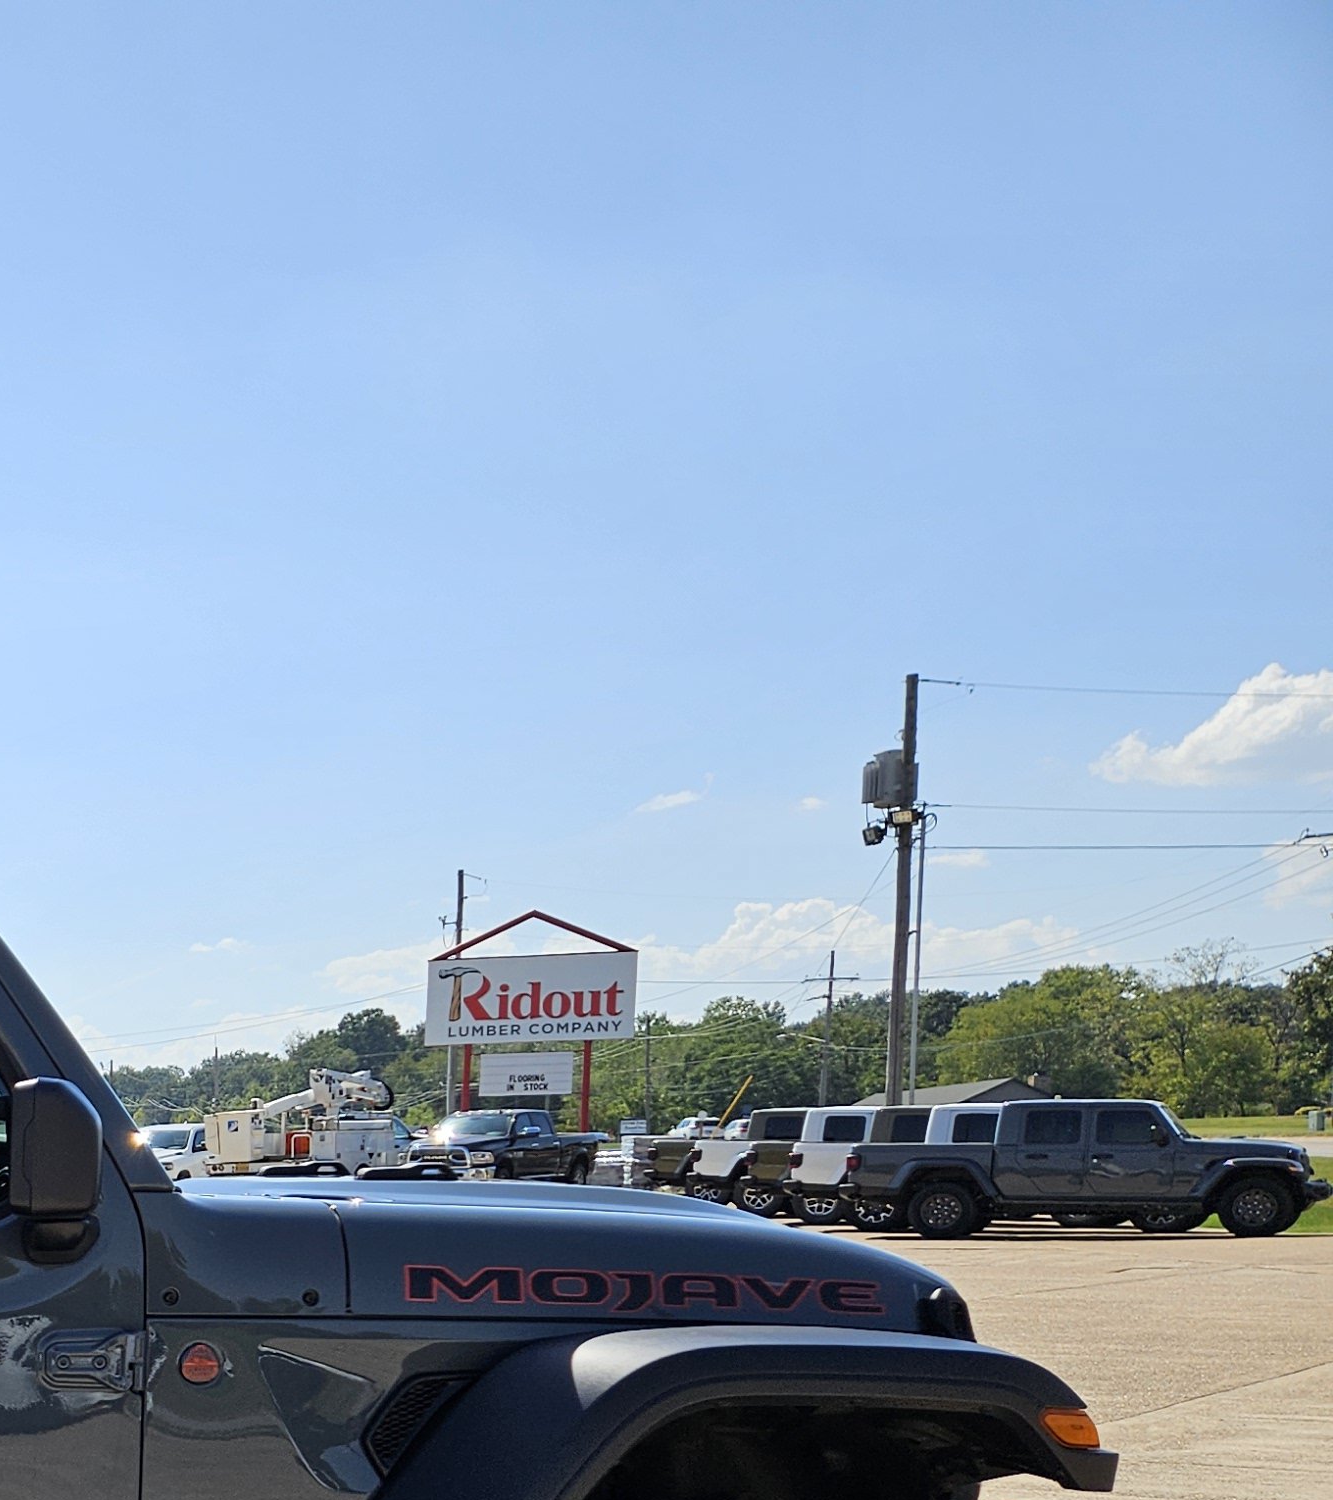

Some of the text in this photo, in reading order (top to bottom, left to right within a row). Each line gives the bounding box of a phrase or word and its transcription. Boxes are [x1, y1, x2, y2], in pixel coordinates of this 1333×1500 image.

[439, 967, 624, 1022] Ridout
[448, 1020, 623, 1038] LUMBER COMPANY
[506, 1082, 550, 1092] IN STOCK
[509, 1073, 546, 1083] FLOORING
[403, 1264, 886, 1315] MOJAVE
